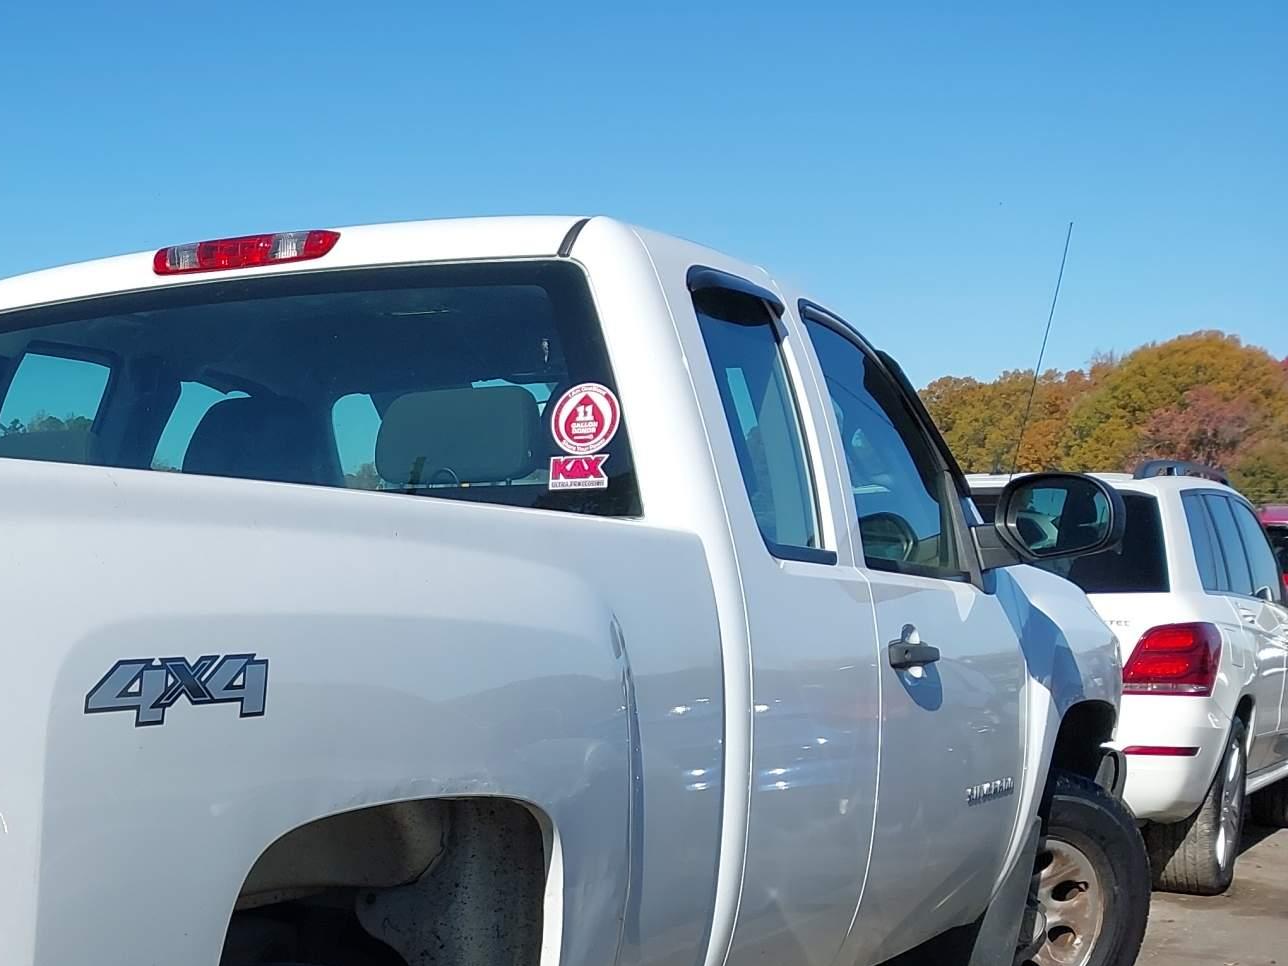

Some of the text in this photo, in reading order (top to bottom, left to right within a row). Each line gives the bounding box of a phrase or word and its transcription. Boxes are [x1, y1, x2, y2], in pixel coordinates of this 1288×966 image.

[576, 404, 594, 421] 11
[571, 427, 597, 435] DONOR
[552, 456, 604, 480] KAX
